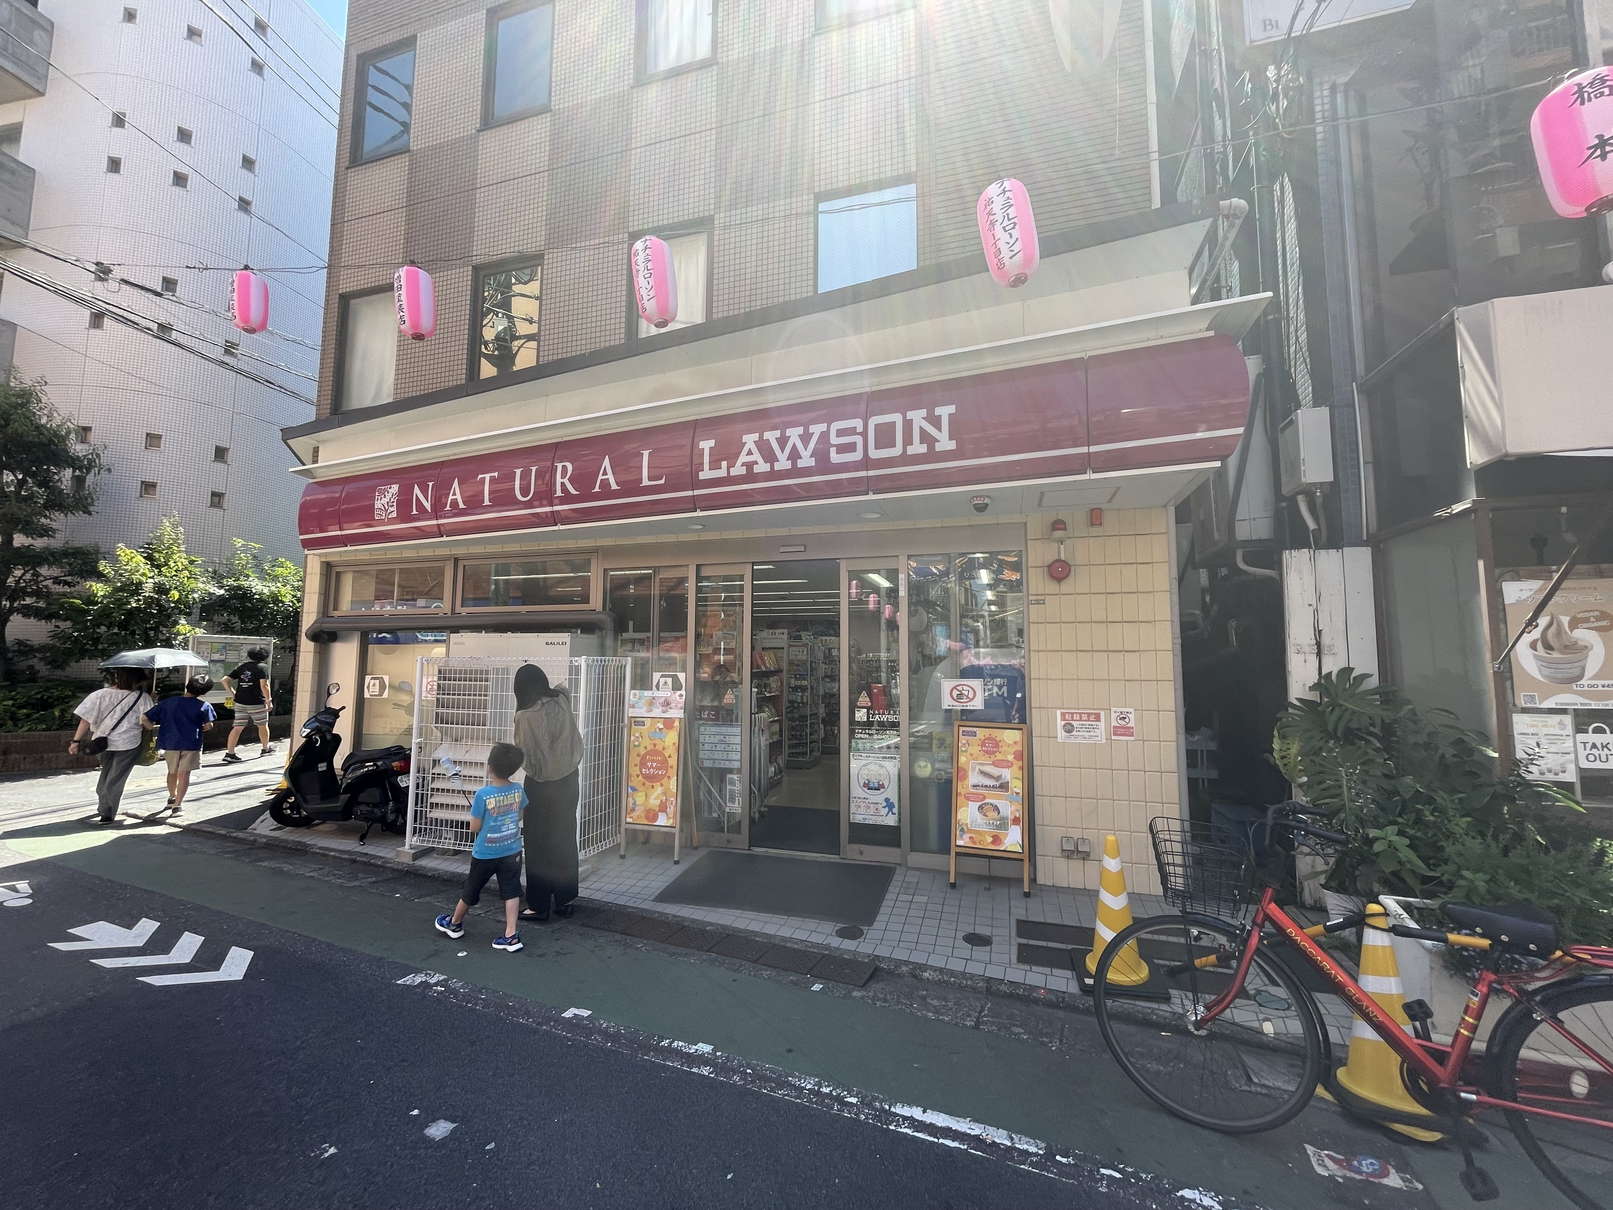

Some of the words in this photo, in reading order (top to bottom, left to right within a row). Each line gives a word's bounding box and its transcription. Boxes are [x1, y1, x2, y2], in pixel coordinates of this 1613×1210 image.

[410, 449, 667, 515] NATURAL
[698, 404, 957, 481] LAWSON
[1579, 741, 1612, 752] TAK
[1585, 752, 1613, 764] OU
